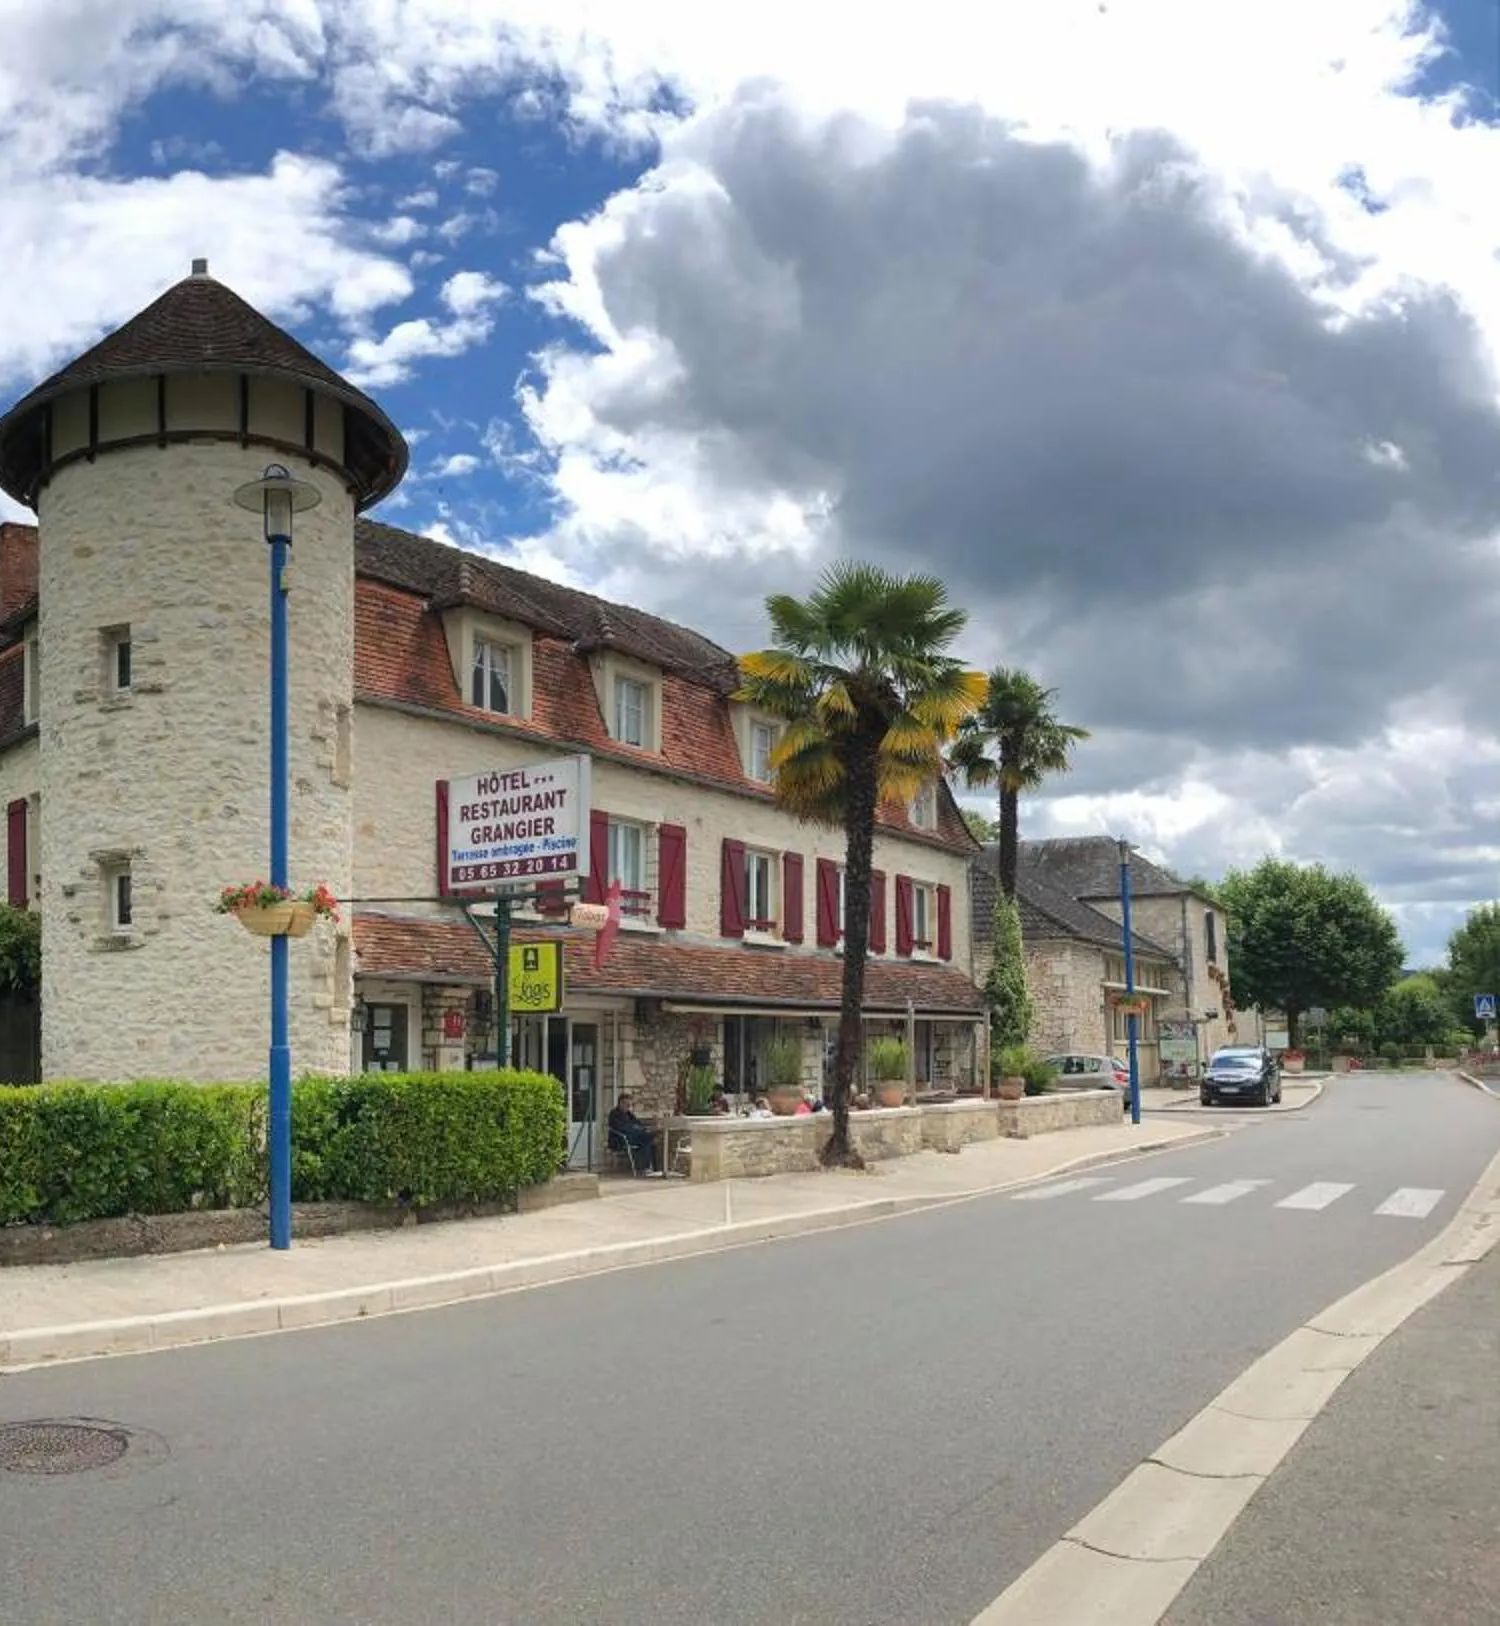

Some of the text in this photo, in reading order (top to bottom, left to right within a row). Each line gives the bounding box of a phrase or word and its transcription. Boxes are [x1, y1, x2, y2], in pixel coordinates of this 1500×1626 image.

[477, 771, 530, 796] HÔTEL
[460, 789, 568, 822] RESTAURANT
[471, 817, 555, 844] GRANGIER
[459, 855, 568, 880] 05 65 32 20 14
